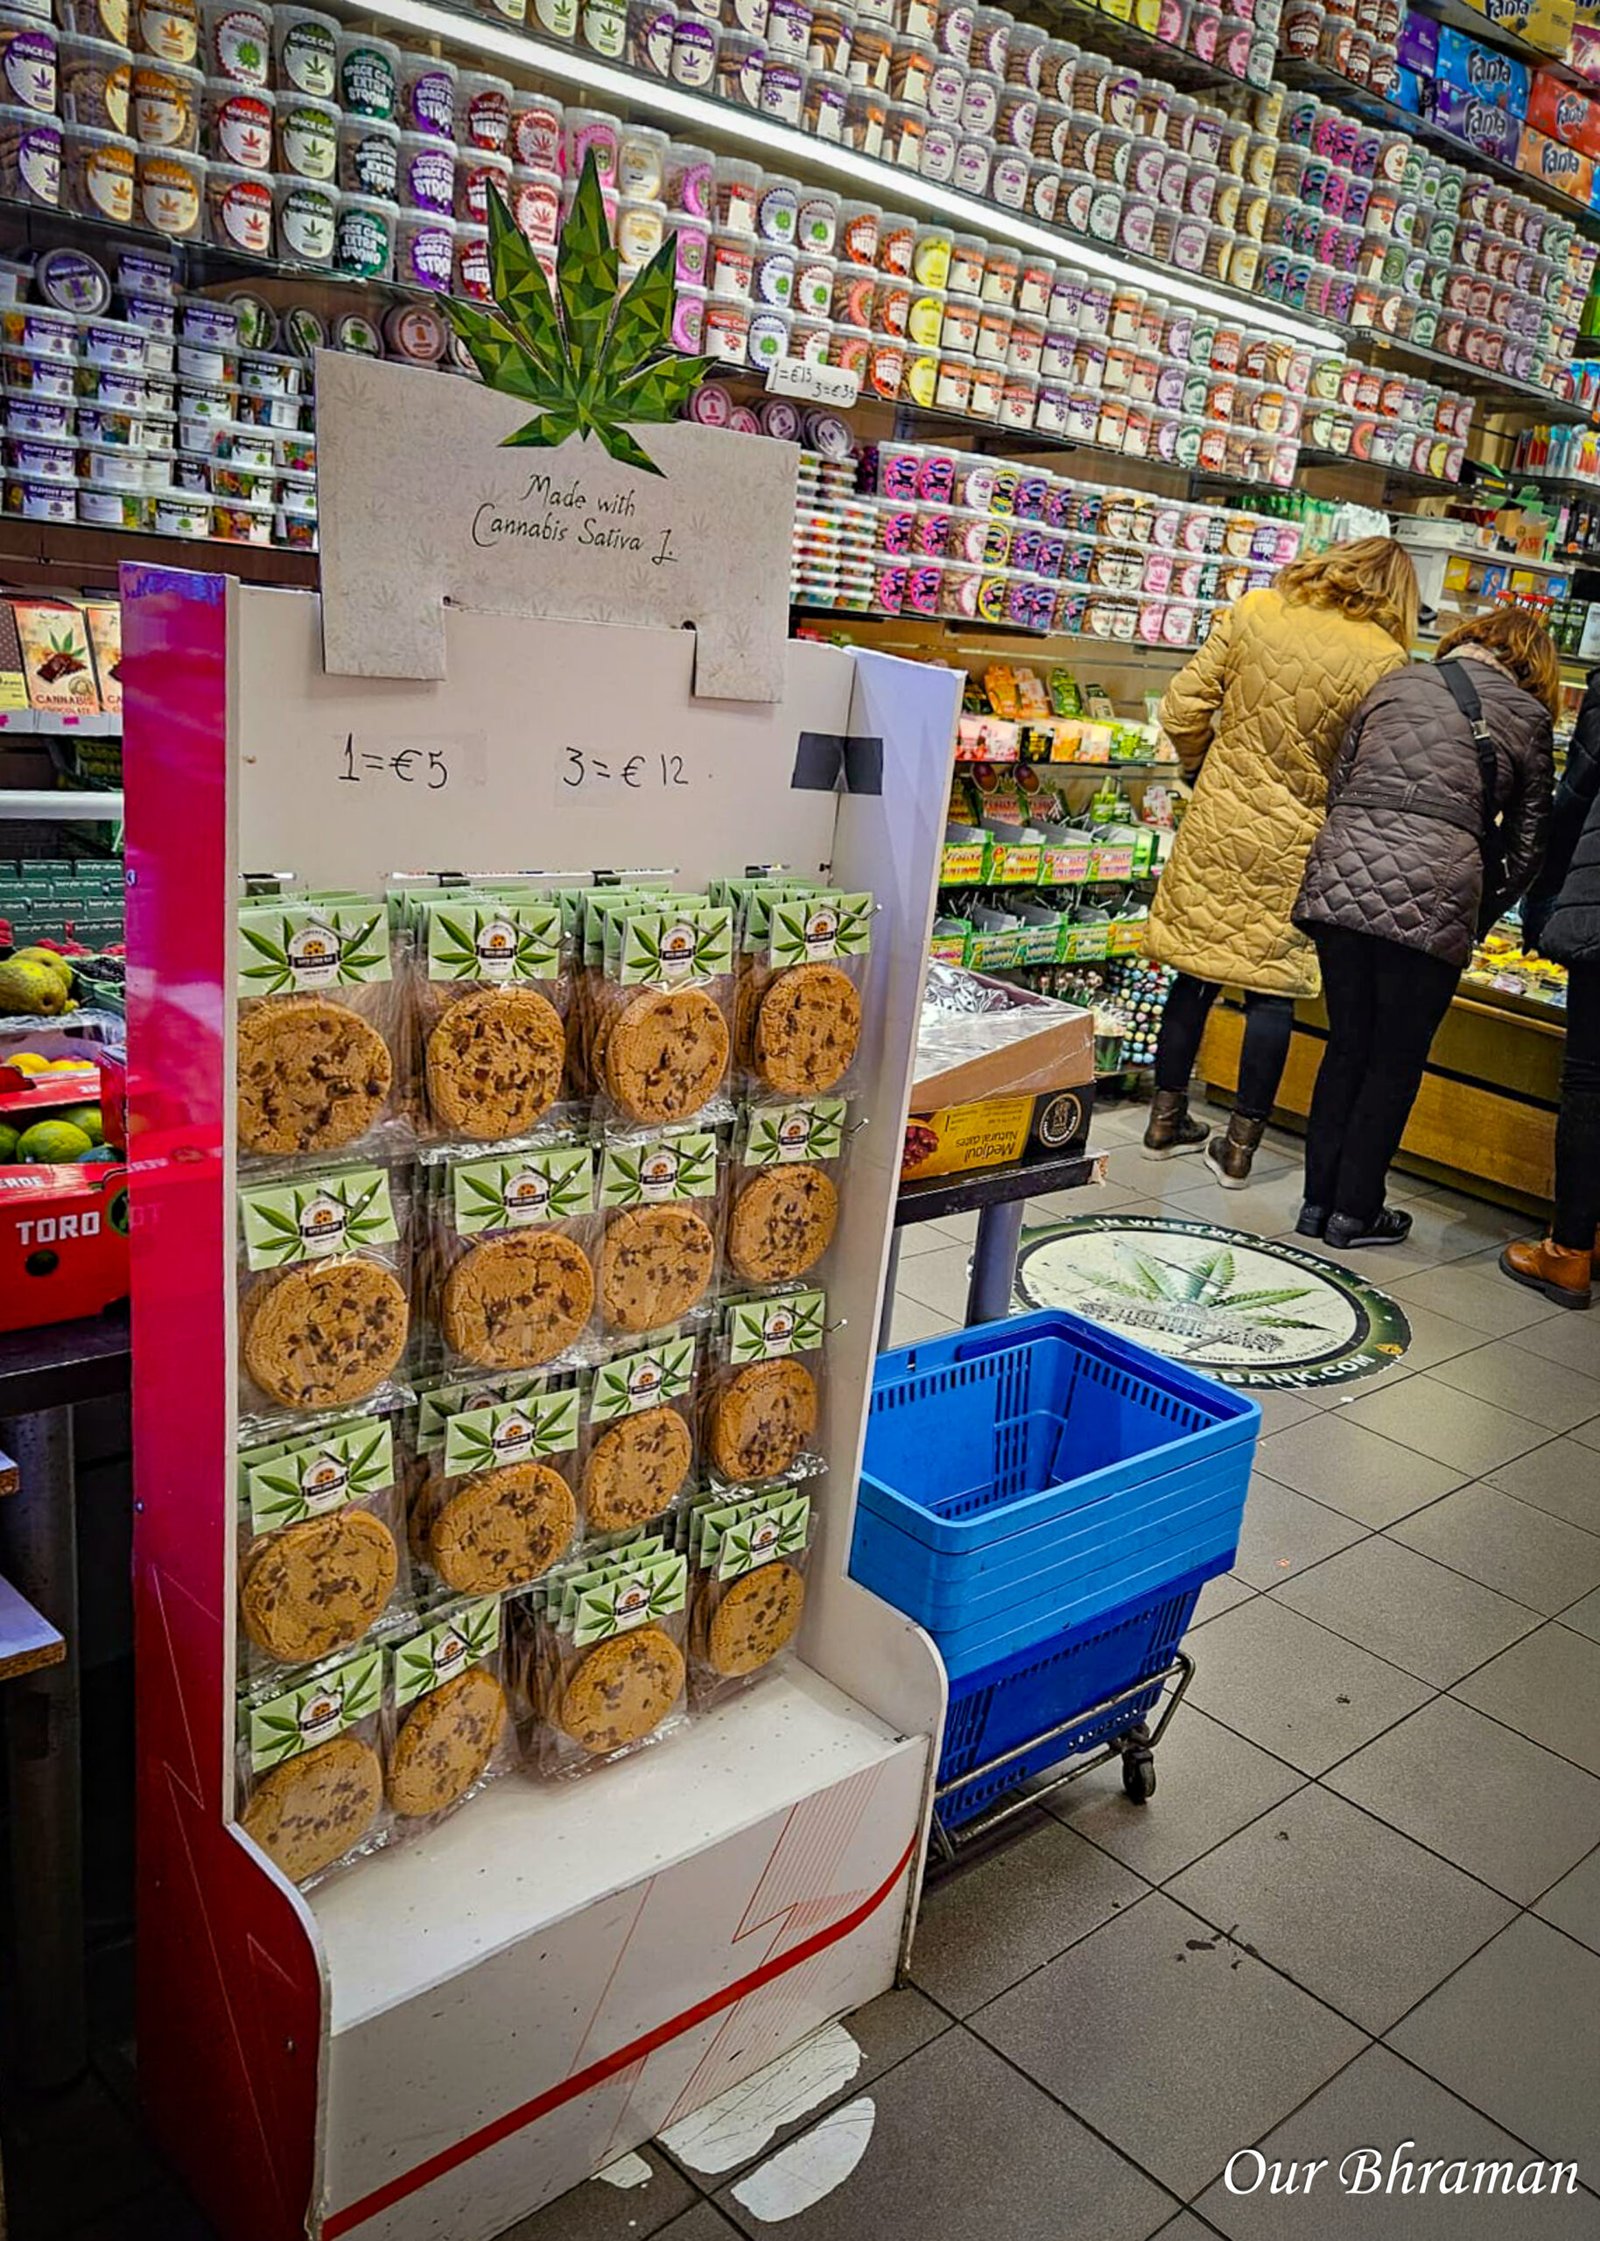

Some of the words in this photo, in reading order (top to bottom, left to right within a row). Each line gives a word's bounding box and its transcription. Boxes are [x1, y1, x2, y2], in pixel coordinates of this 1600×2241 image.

[1467, 47, 1513, 86] Fanta
[1464, 101, 1508, 138] Fanta
[1540, 140, 1581, 176] Fanta
[520, 474, 587, 509] Made
[597, 490, 636, 517] with
[472, 503, 568, 548] Cannabis
[577, 518, 646, 552] Sativa
[964, 1142, 1016, 1163] Medjoul
[15, 1211, 101, 1246] TORO
[1094, 1217, 1121, 1228] IN
[1129, 1218, 1204, 1235] WEED
[1252, 1240, 1333, 1271] TRUST
